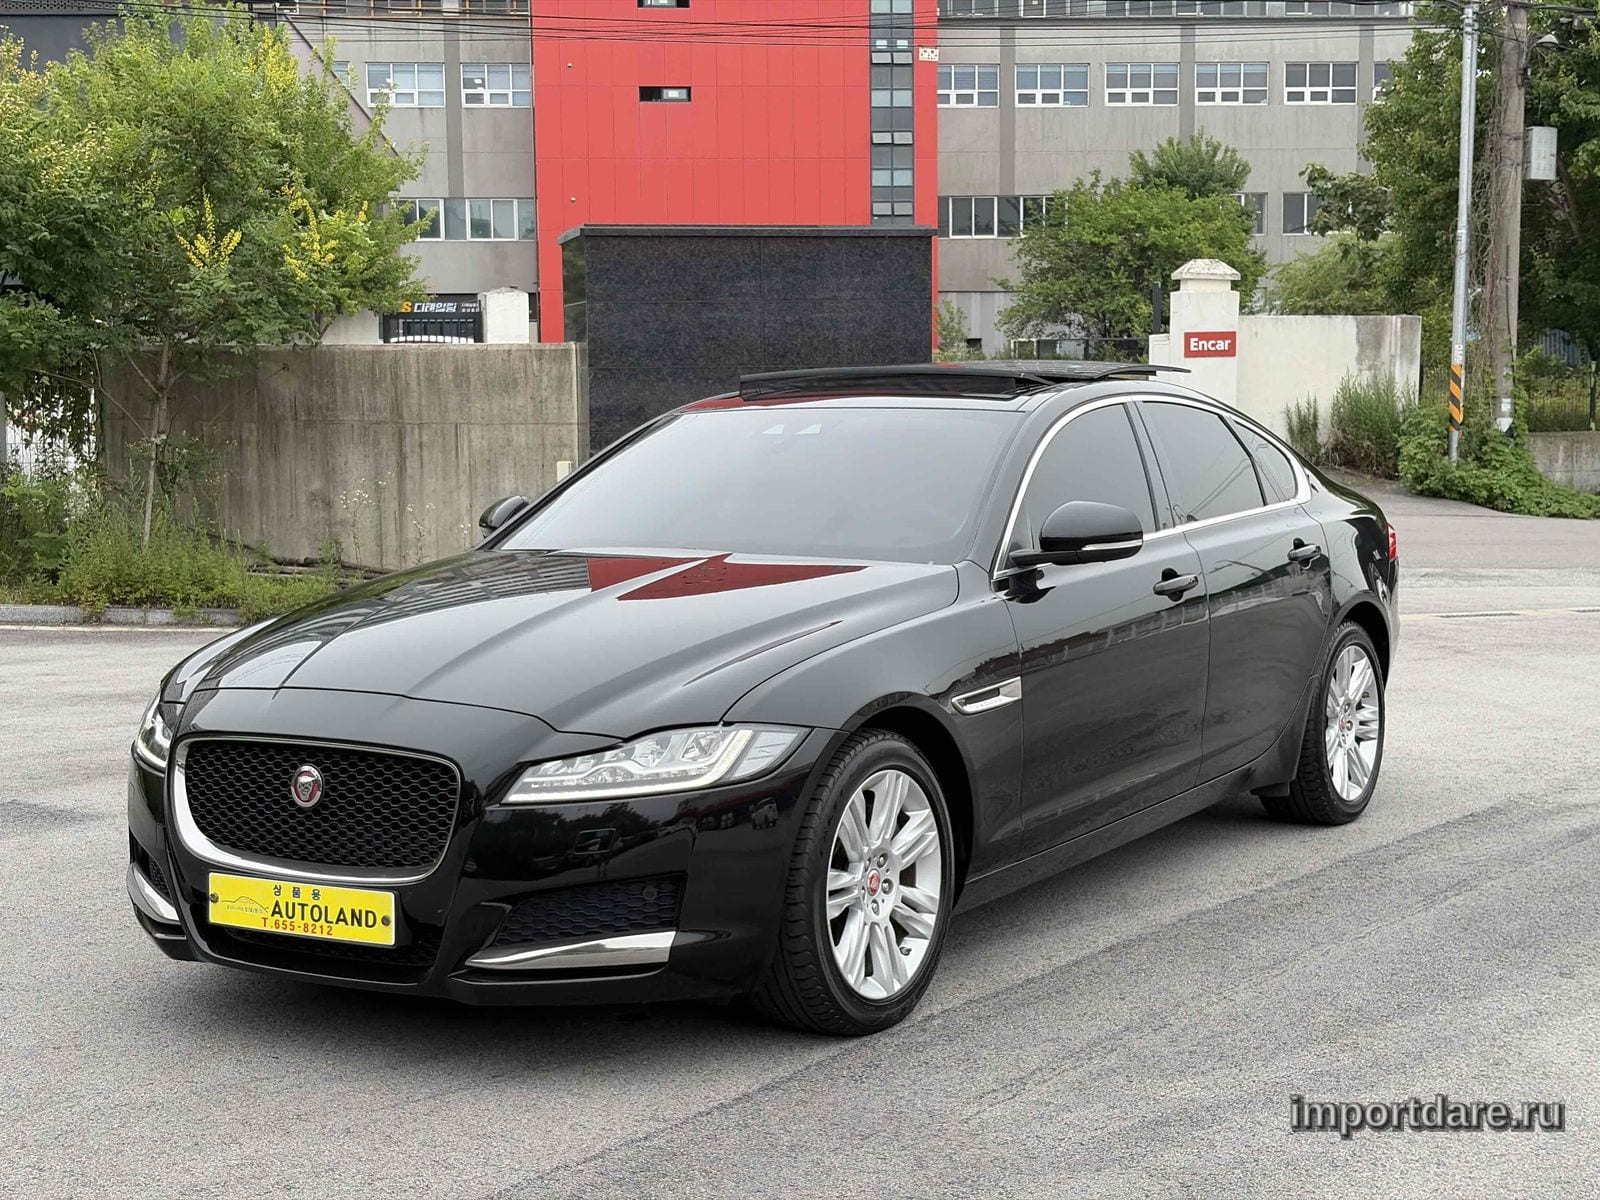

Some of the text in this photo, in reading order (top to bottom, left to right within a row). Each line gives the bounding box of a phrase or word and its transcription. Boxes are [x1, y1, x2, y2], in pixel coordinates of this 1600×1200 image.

[1190, 337, 1231, 351] Encar
[270, 900, 378, 929] AUTOLAND
[261, 917, 334, 936] T.655-8212
